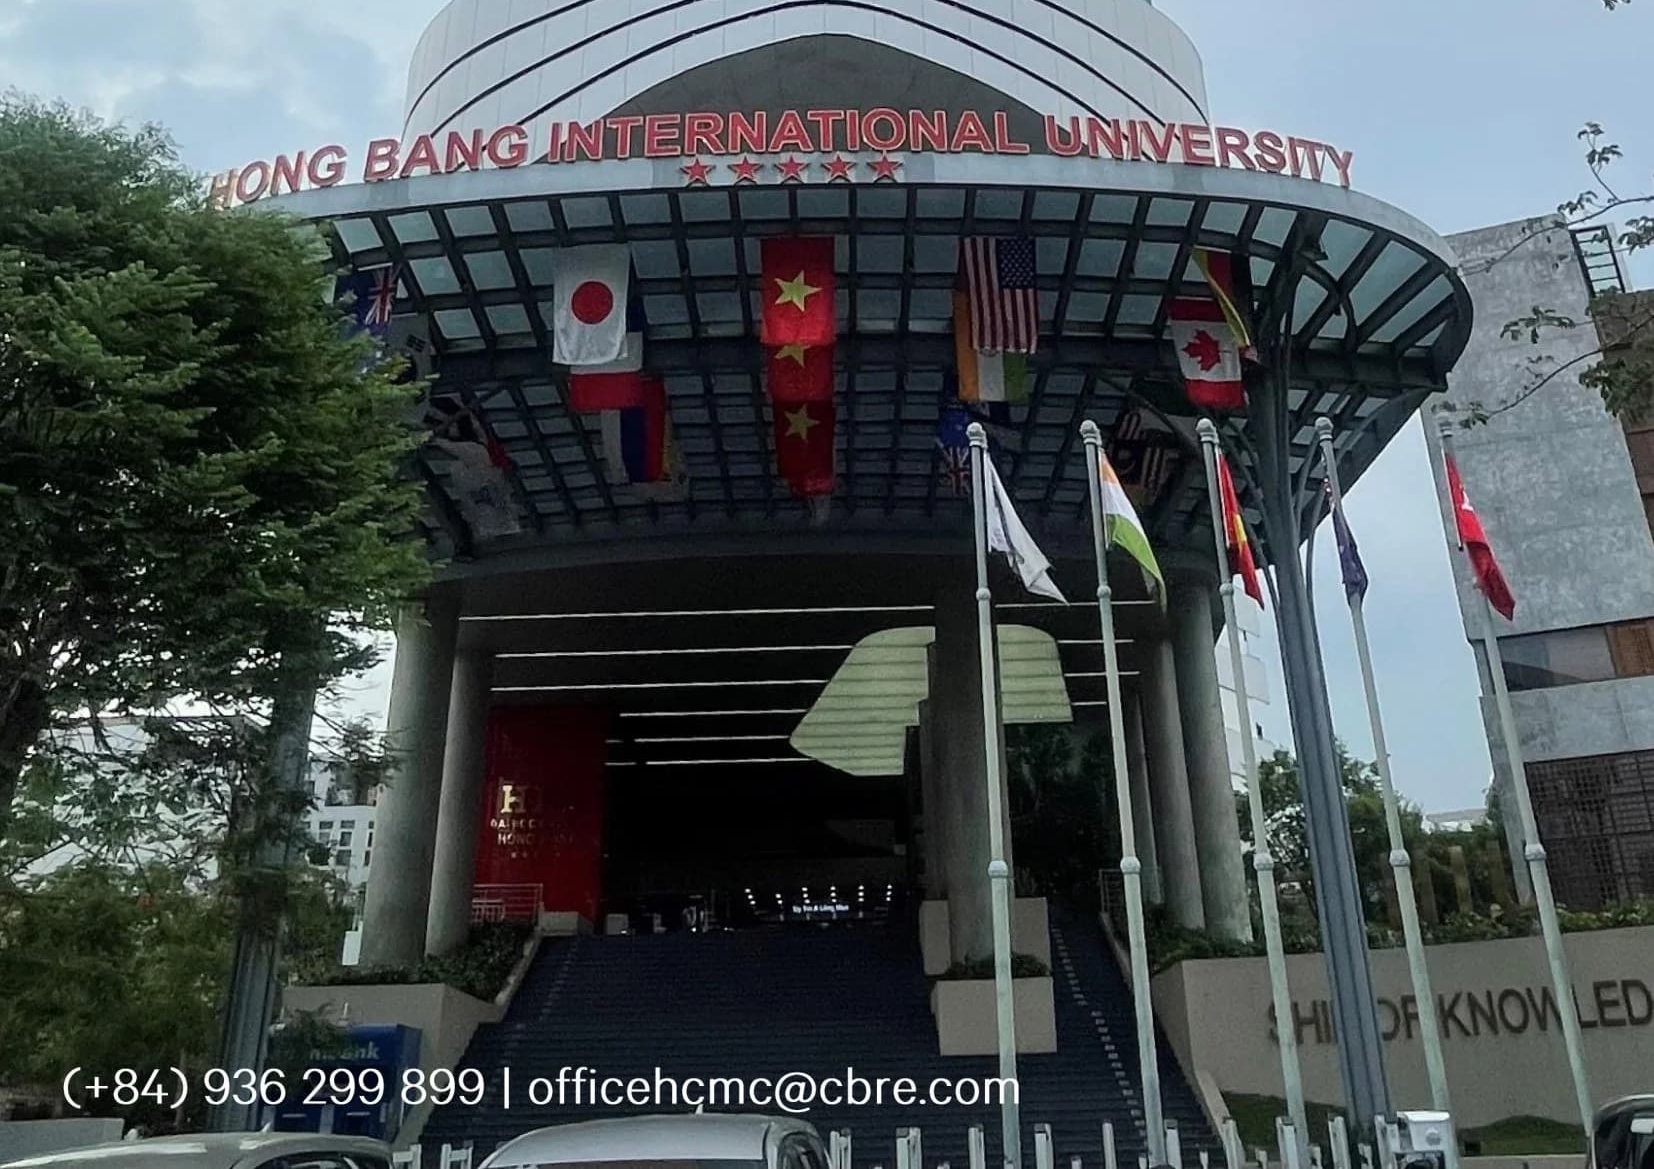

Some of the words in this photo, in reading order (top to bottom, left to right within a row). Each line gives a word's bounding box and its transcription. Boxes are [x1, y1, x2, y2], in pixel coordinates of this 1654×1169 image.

[207, 144, 347, 210] HONG
[364, 124, 529, 182] BANG
[547, 108, 1030, 163] INTERNATIONAL
[1045, 114, 1354, 188] UNIVERSITY
